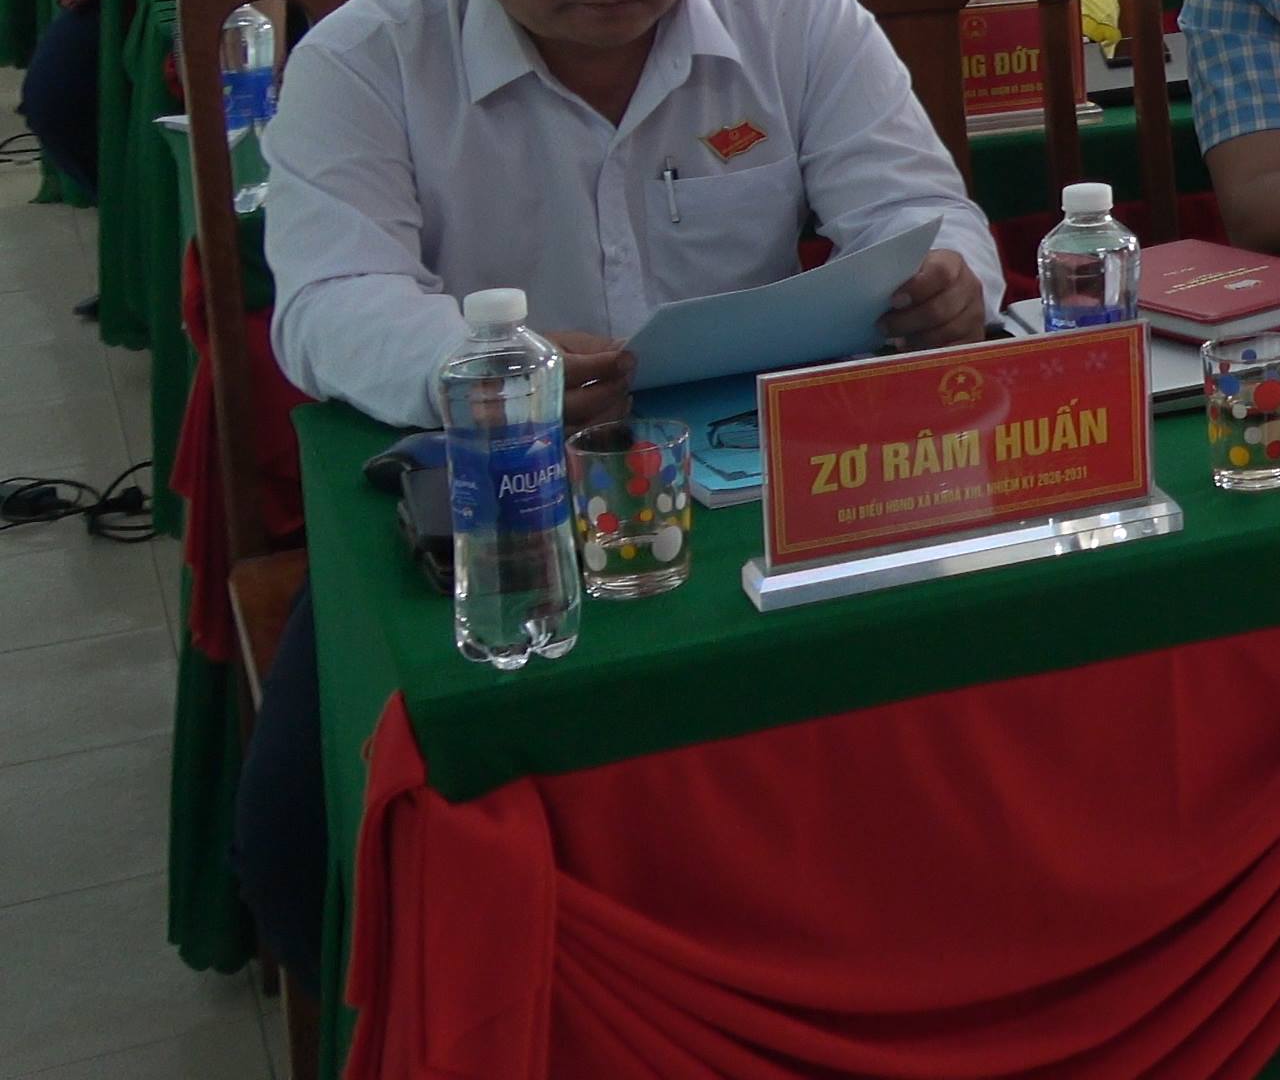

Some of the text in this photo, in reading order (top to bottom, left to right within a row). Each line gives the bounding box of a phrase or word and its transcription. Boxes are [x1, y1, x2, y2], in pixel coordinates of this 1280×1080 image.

[809, 397, 1109, 496] ZƠ RÂM HUẤN
